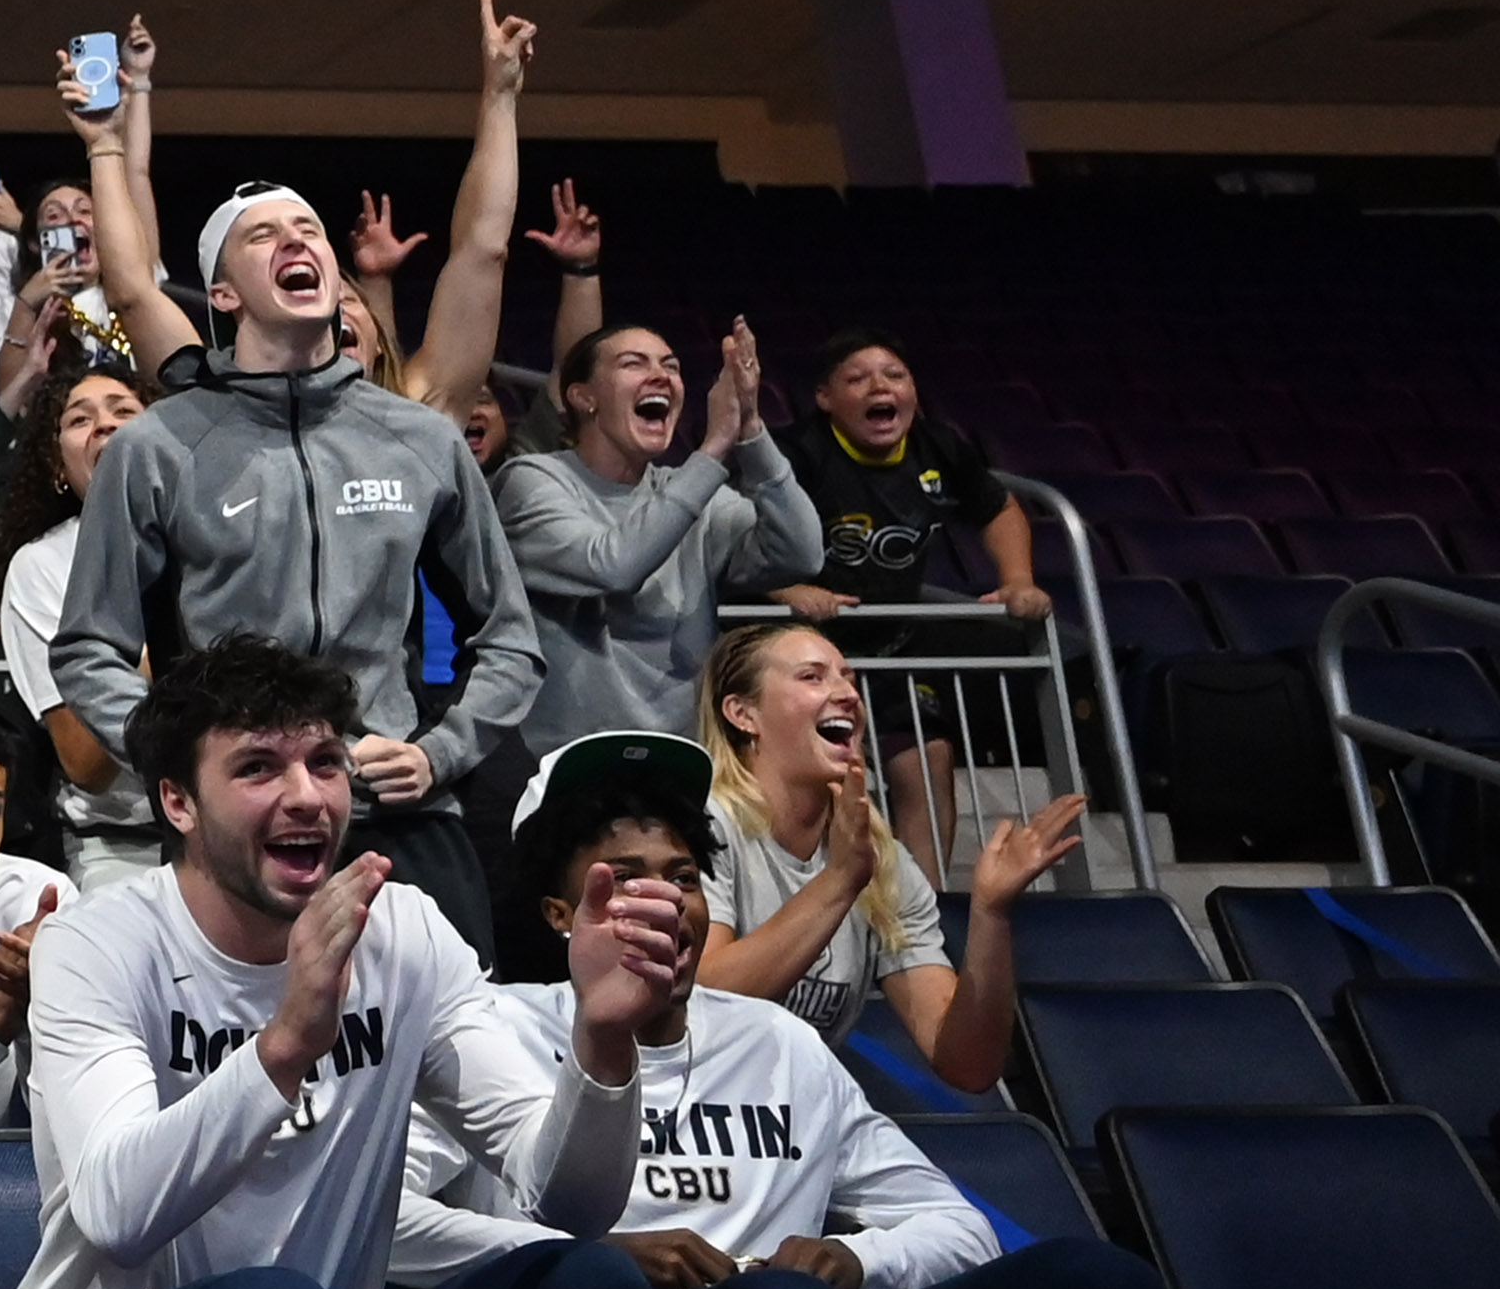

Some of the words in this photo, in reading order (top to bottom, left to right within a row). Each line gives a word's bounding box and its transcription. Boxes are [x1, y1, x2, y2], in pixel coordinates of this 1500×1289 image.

[342, 479, 403, 504] CBU
[336, 502, 414, 515] BASKETBALL
[690, 1102, 735, 1157] IT
[740, 1104, 803, 1161] IN.
[645, 1164, 732, 1203] CBU
